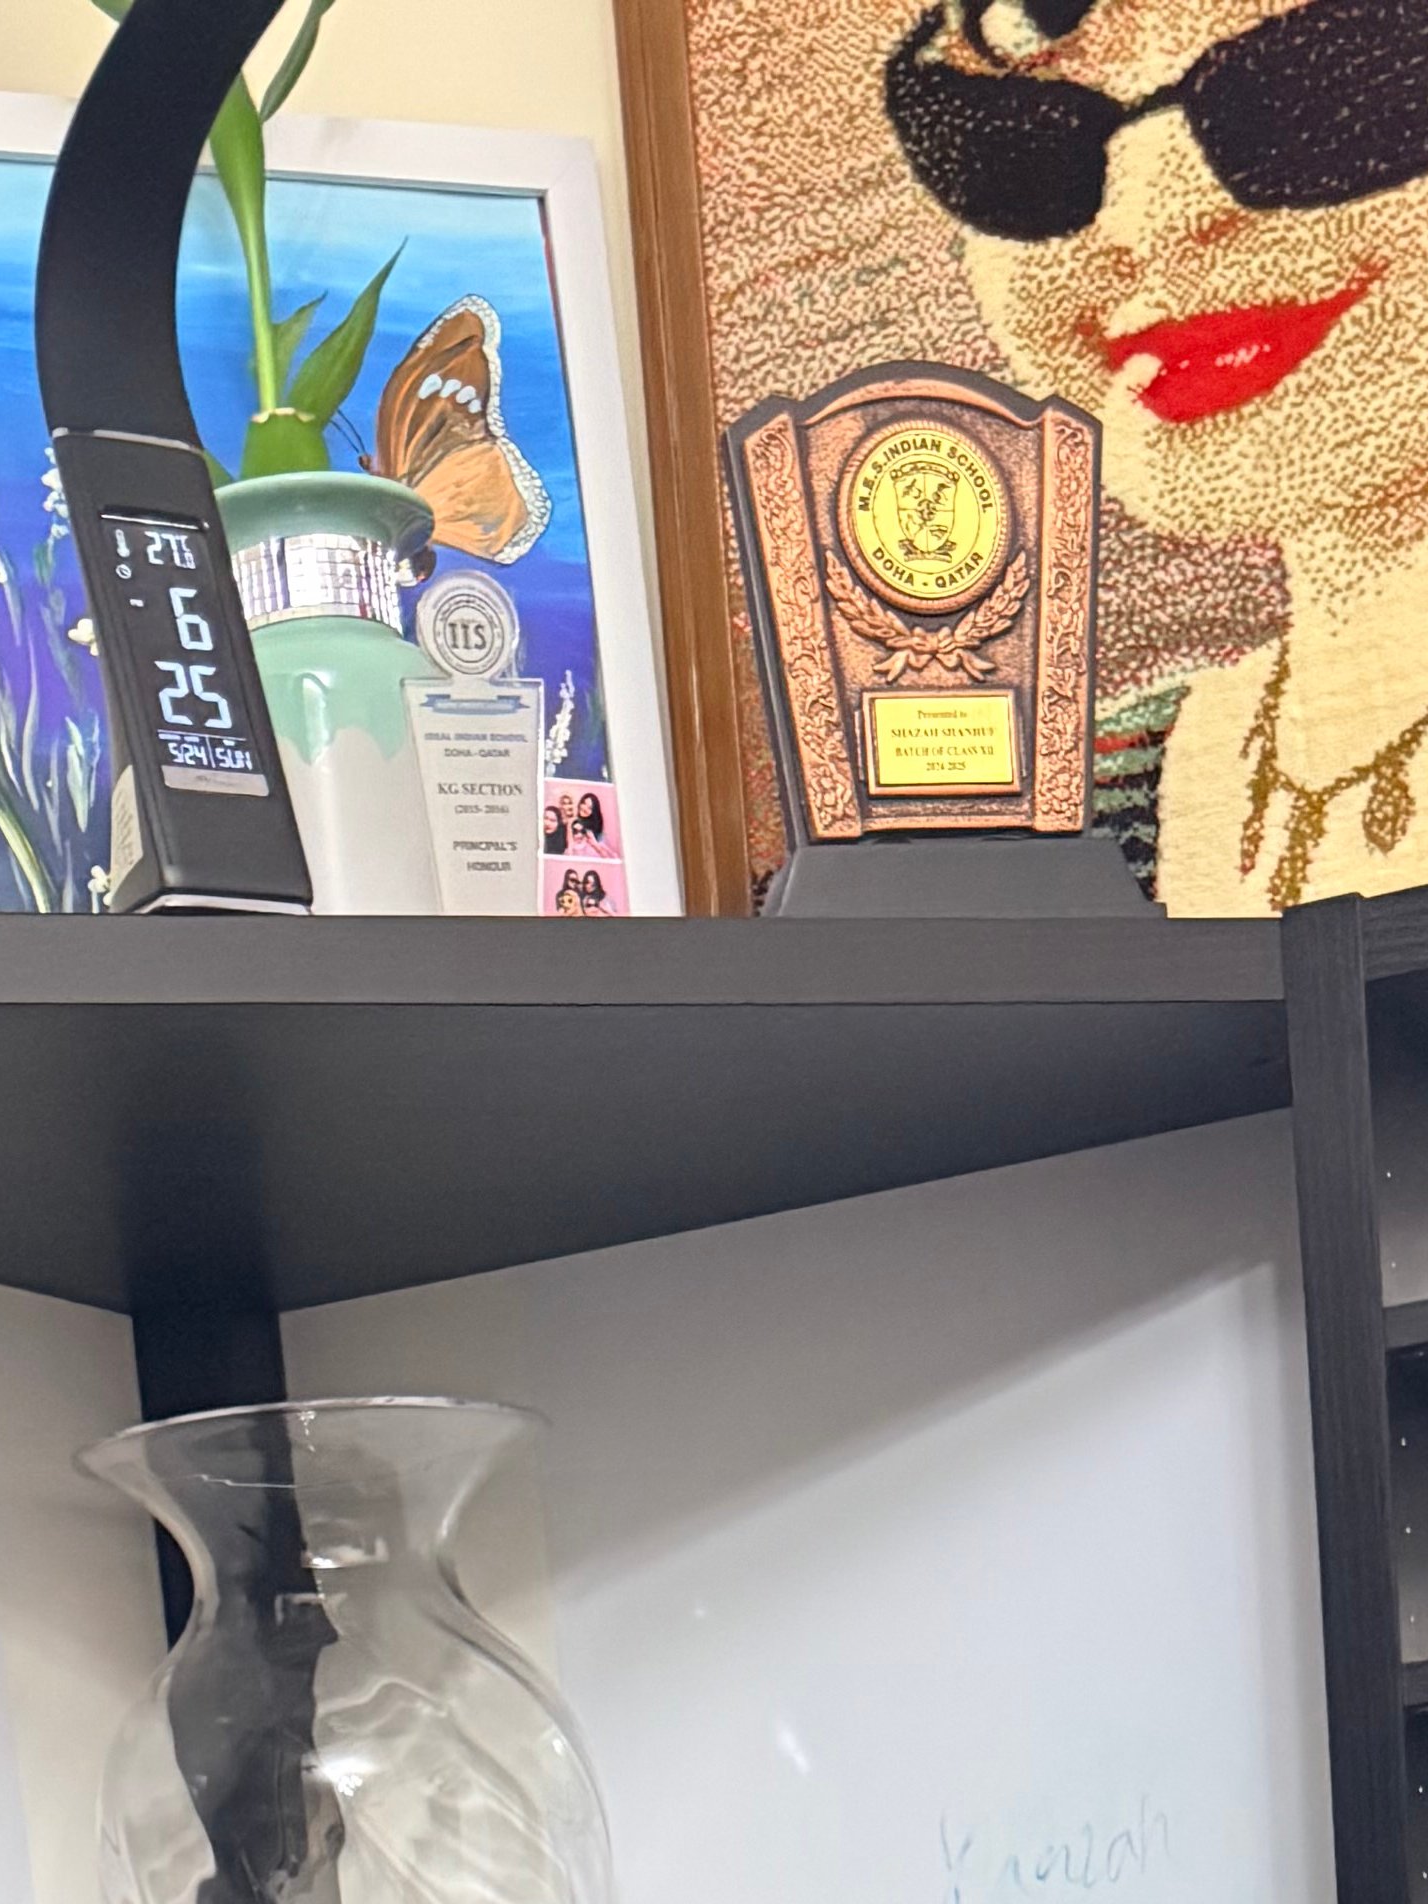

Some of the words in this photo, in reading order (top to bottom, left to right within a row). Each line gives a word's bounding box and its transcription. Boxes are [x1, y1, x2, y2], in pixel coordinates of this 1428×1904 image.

[947, 446, 993, 514] SCHOOL
[872, 547, 914, 586] DOHA
[935, 551, 984, 588] QATAR
[169, 587, 213, 650] 6
[448, 623, 486, 649] IIS
[154, 661, 232, 728] 25
[438, 783, 459, 795] KG
[462, 783, 523, 796] SECTION
